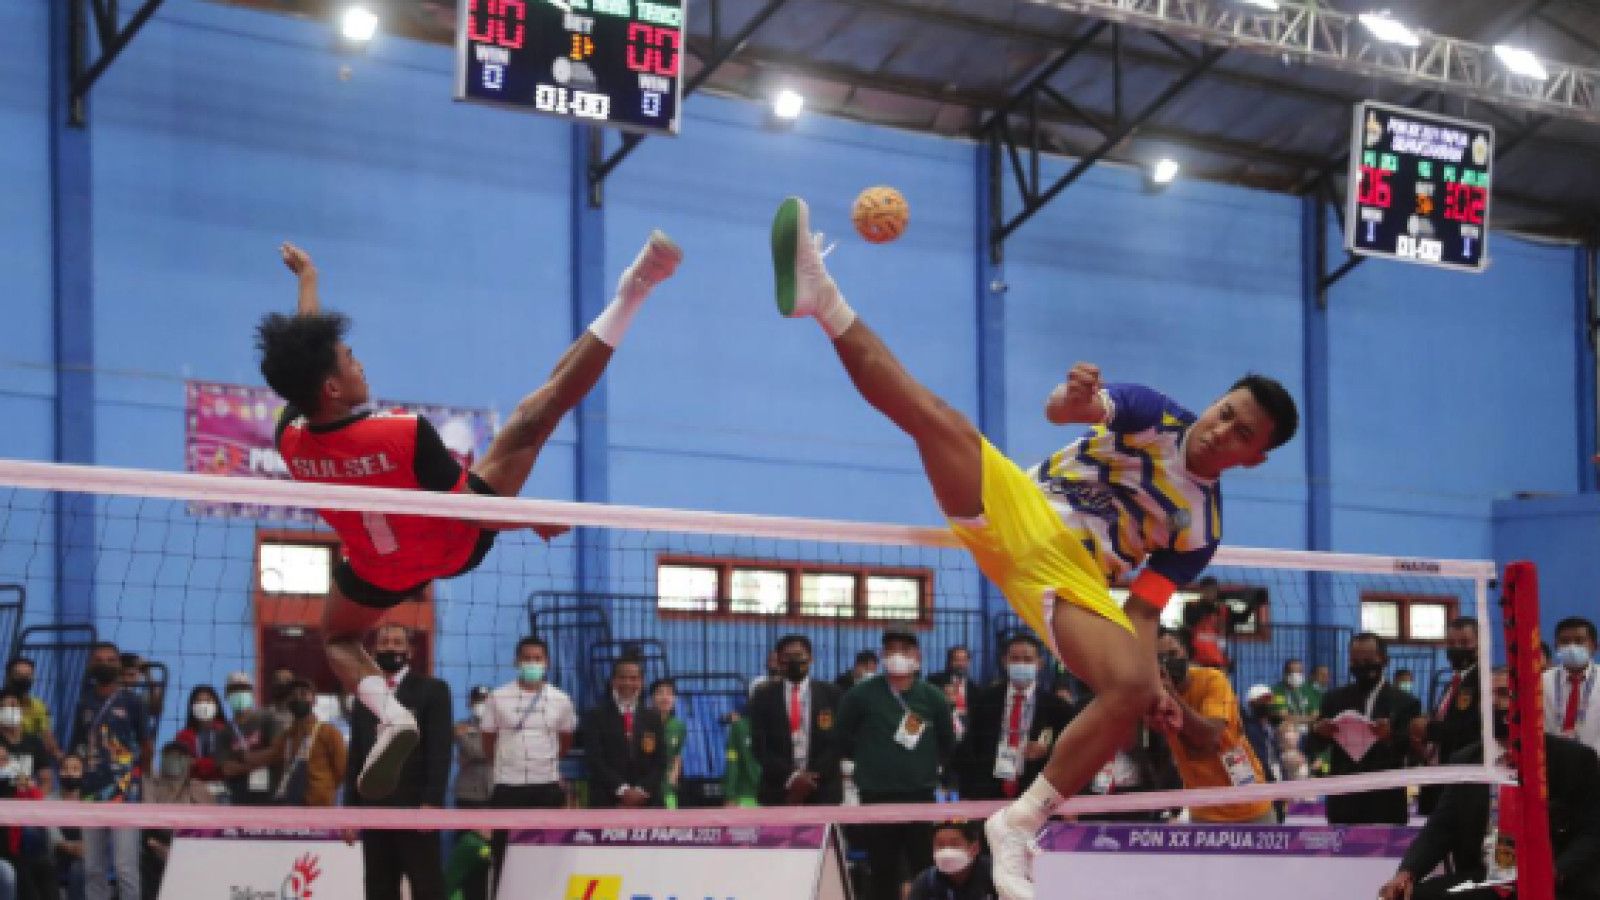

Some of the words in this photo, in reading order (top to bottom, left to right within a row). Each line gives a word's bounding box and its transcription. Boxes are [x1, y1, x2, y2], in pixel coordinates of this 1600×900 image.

[626, 22, 680, 75] 00
[291, 453, 397, 478] SULSEL
[1128, 831, 1164, 847] PON
[1168, 831, 1192, 847] XX
[1194, 831, 1253, 848] PAPUA
[1256, 832, 1289, 850] 2021
